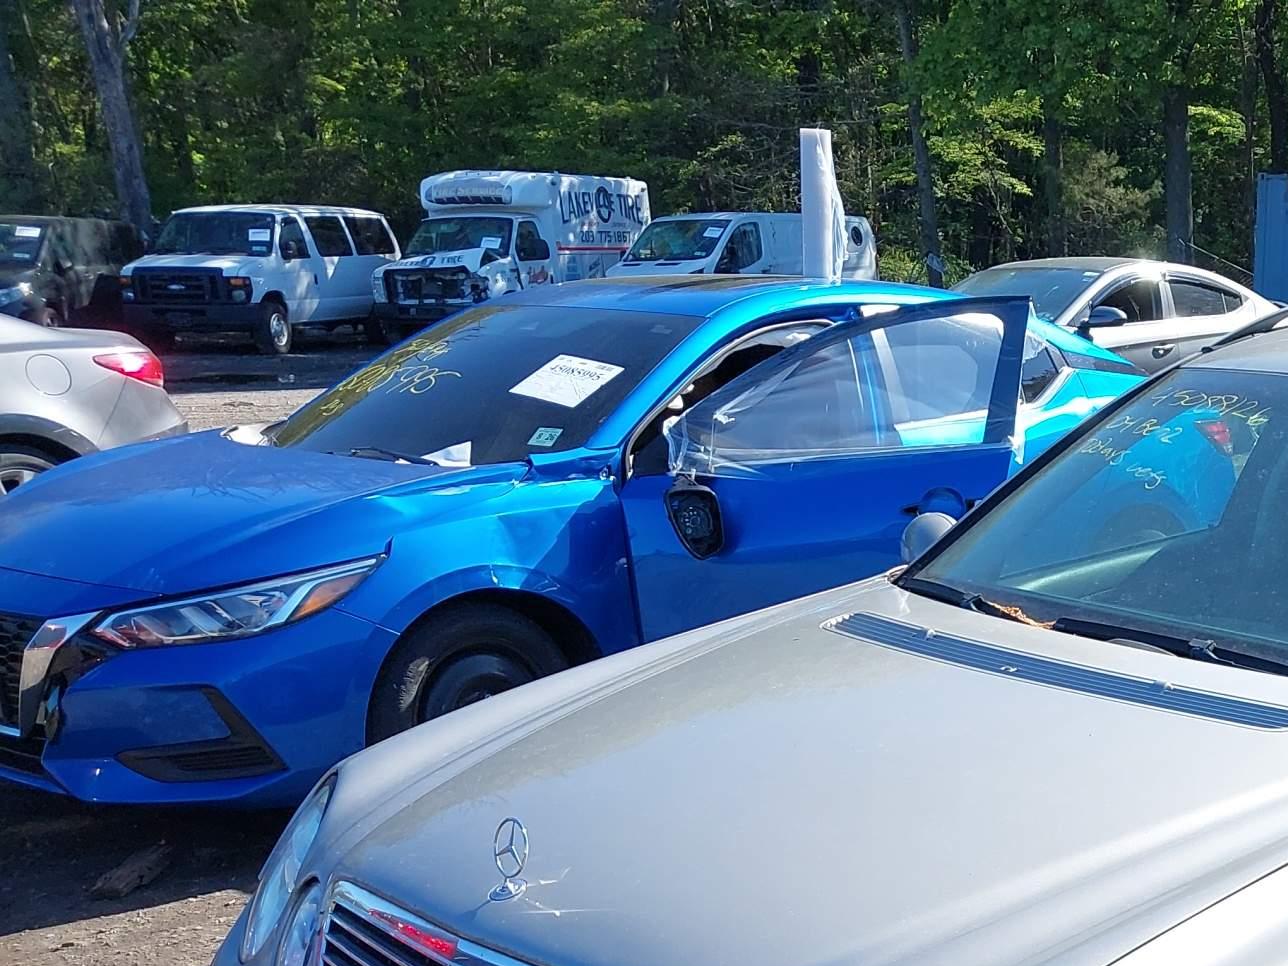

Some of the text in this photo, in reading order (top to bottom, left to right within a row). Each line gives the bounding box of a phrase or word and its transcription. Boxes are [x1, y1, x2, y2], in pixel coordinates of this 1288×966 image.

[616, 193, 643, 226] TIRE
[580, 230, 595, 243] 203
[1152, 386, 1271, 426] 45088126
